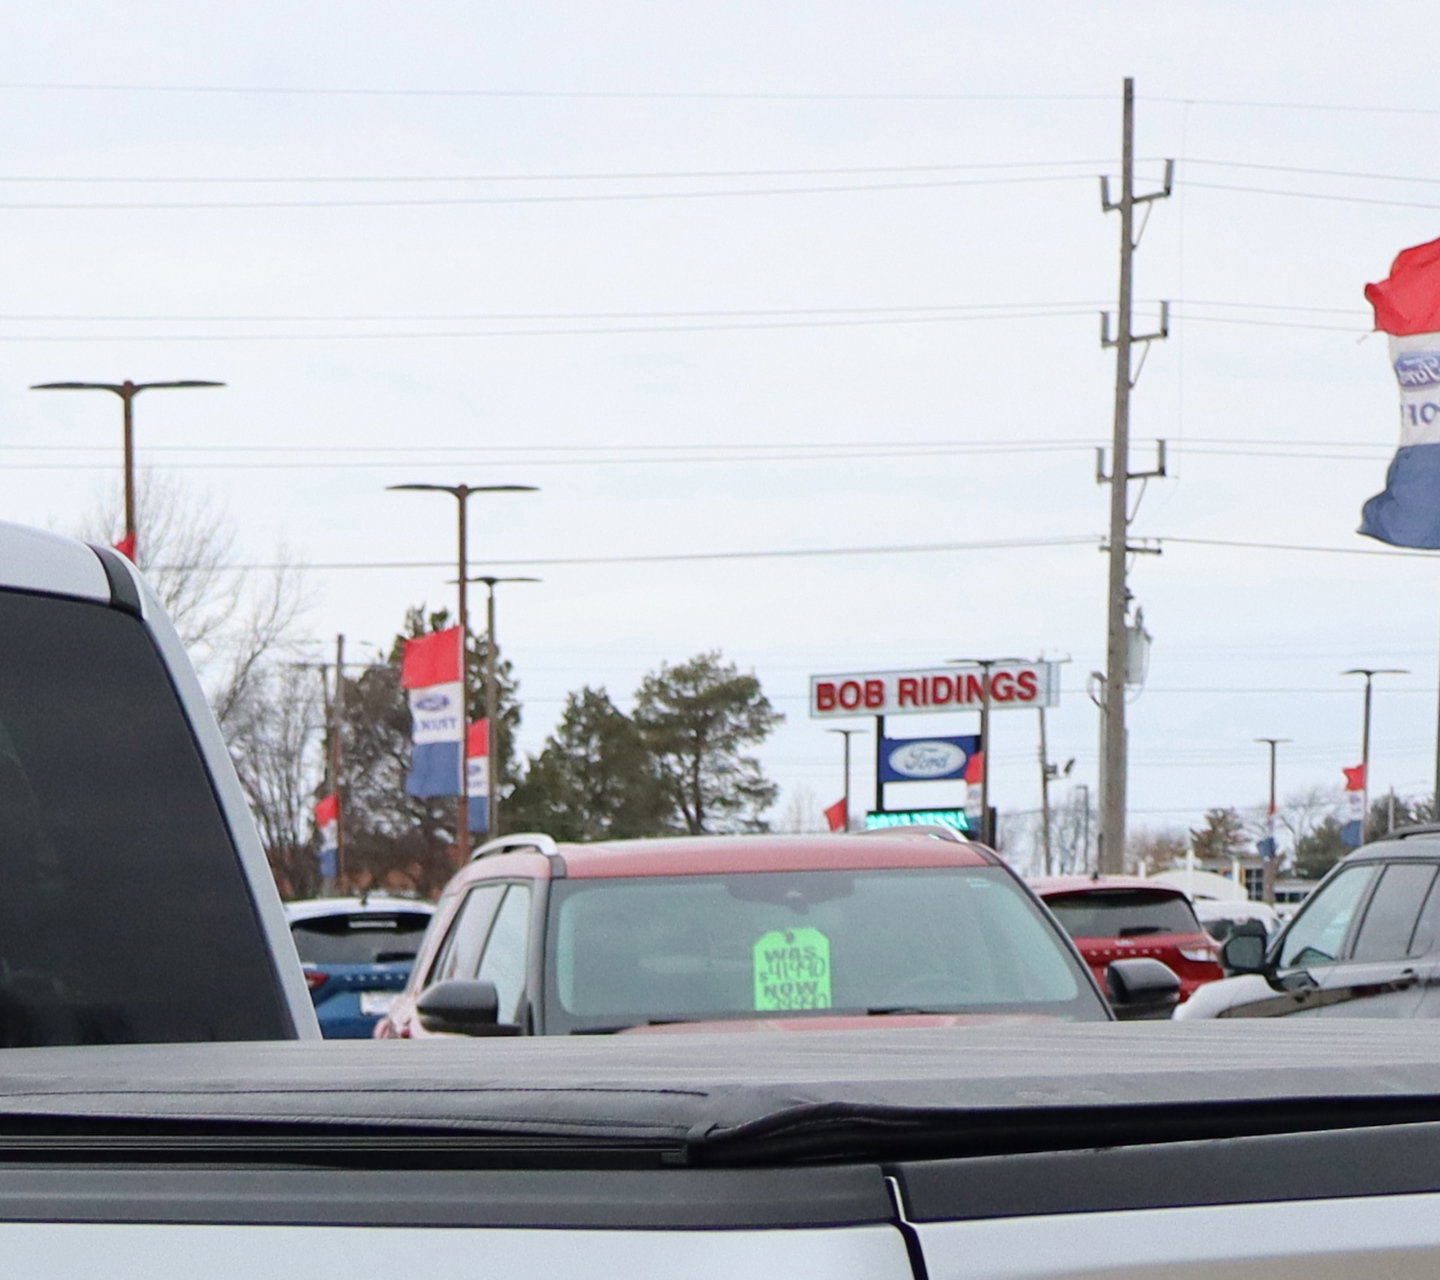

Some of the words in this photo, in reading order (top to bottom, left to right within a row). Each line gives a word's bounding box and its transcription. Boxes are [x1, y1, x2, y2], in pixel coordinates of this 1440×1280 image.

[816, 679, 885, 711] BOB
[897, 671, 1038, 707] RIDINGS
[764, 946, 818, 963] WAS
[764, 981, 819, 998] NOW
